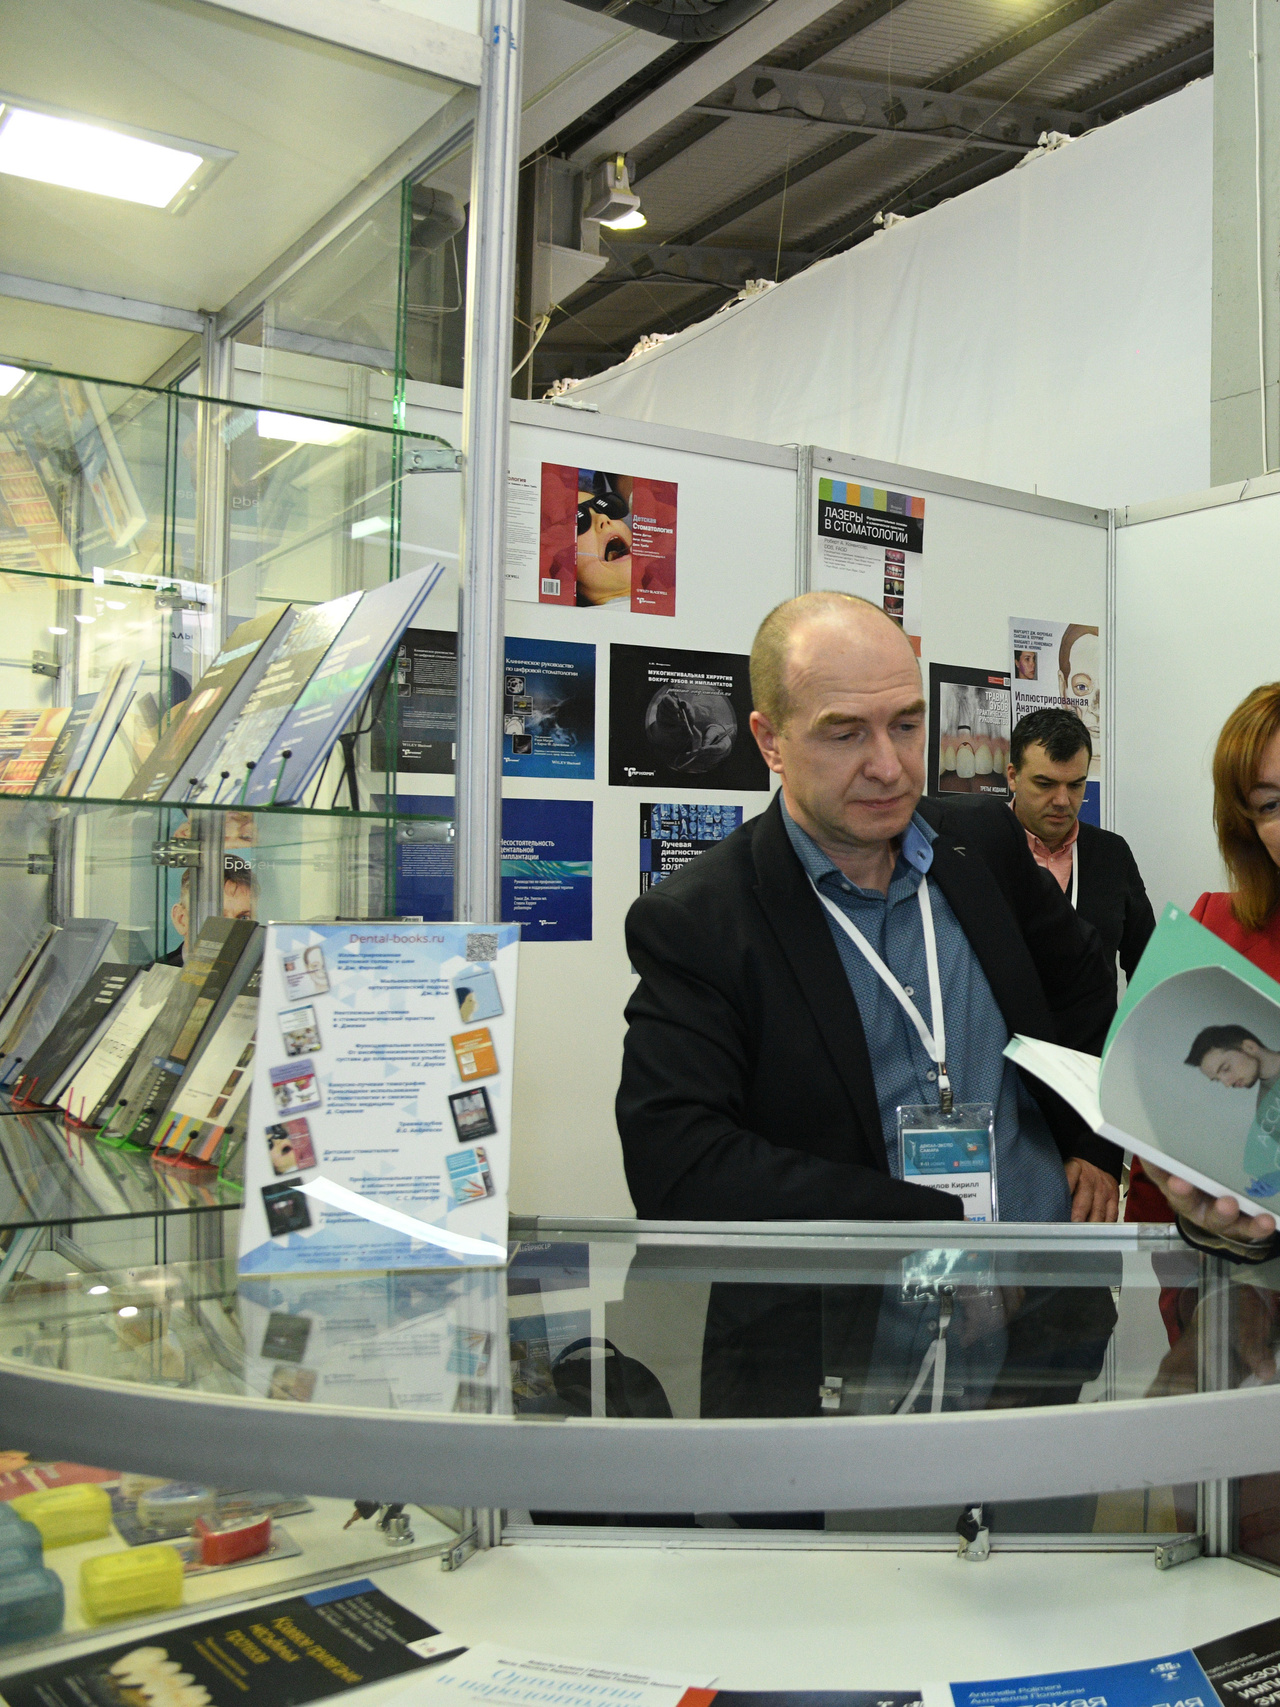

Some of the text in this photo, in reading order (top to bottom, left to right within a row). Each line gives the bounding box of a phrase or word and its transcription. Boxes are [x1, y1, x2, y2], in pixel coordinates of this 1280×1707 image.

[633, 514, 656, 524] Детская
[824, 506, 864, 523] ЛАЗЕРЫ
[632, 522, 673, 534] Стоматология
[824, 518, 908, 543] В СТОМАТОЛОГИИ
[505, 658, 540, 667] Клиническое
[513, 666, 541, 674] цифровой
[648, 669, 705, 679] МУКОГИНГИВАЛЬНАЯ
[985, 691, 1008, 702] ТРАВМА
[1014, 691, 1089, 706] Иллюстрированная
[989, 700, 1009, 711] ЗУБОВ
[661, 840, 692, 849] Лучевая
[350, 933, 445, 944] Dental-books.ru
[968, 1683, 1061, 1698] Antonella Polimeni
